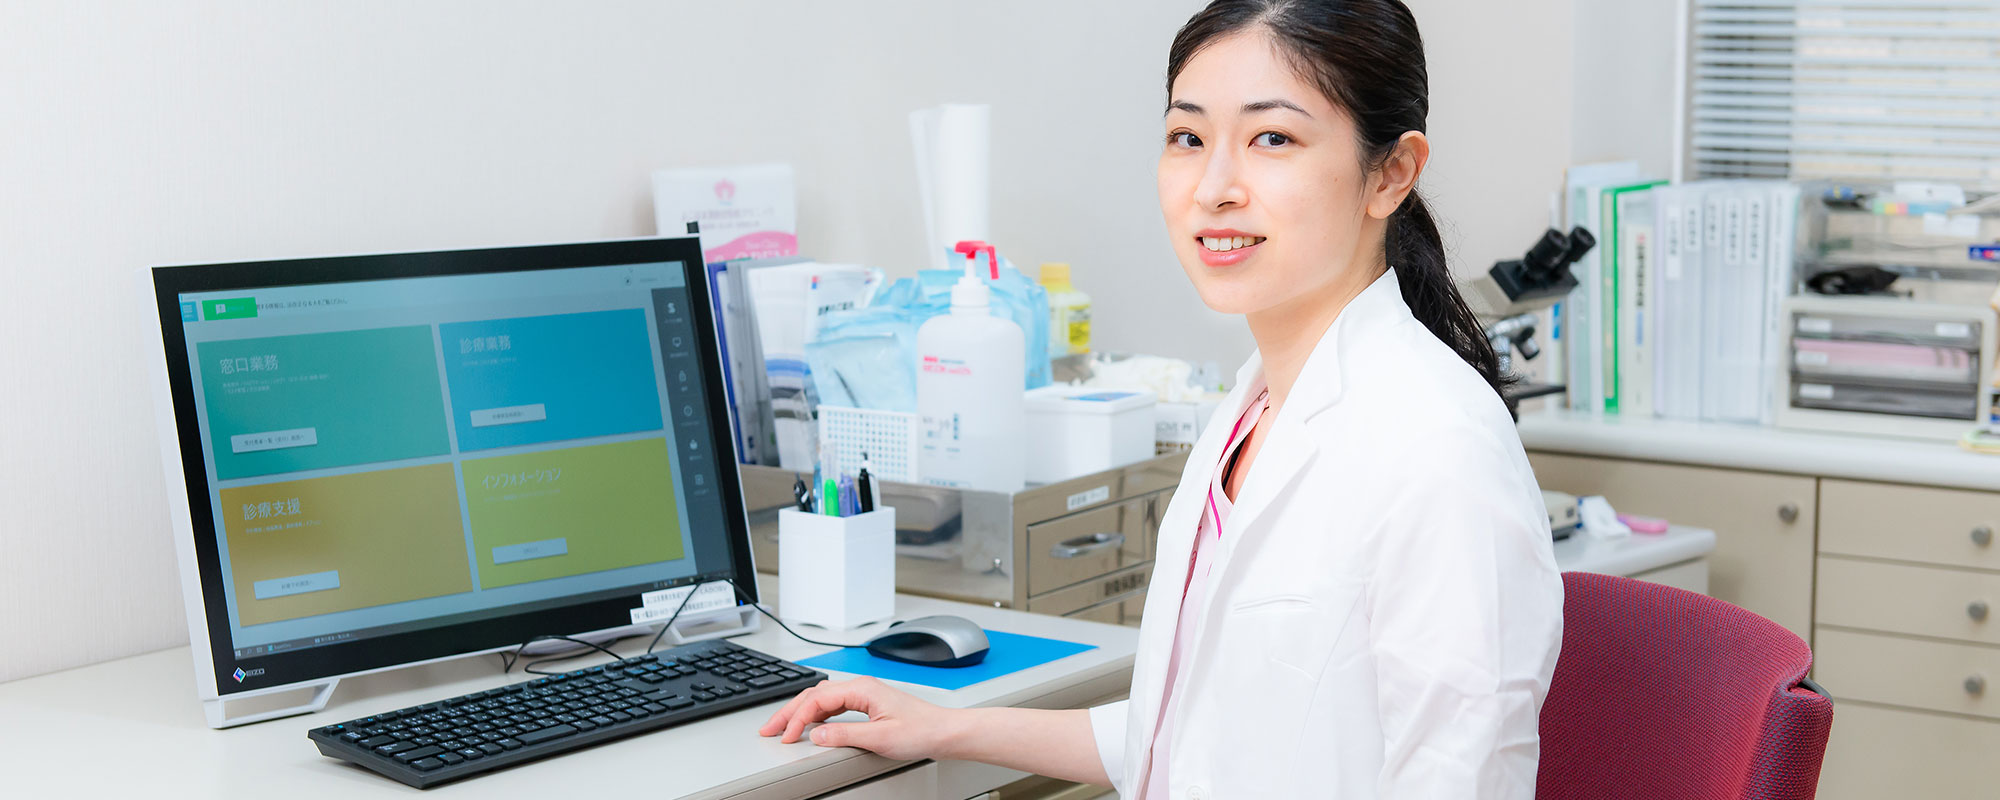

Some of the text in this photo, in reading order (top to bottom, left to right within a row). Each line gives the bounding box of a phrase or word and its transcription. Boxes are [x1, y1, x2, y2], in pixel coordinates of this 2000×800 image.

[460, 335, 511, 354] 診療業務
[219, 354, 279, 375] 窓口業務
[482, 467, 562, 489] インフォメーション
[242, 497, 302, 521] 診療支援
